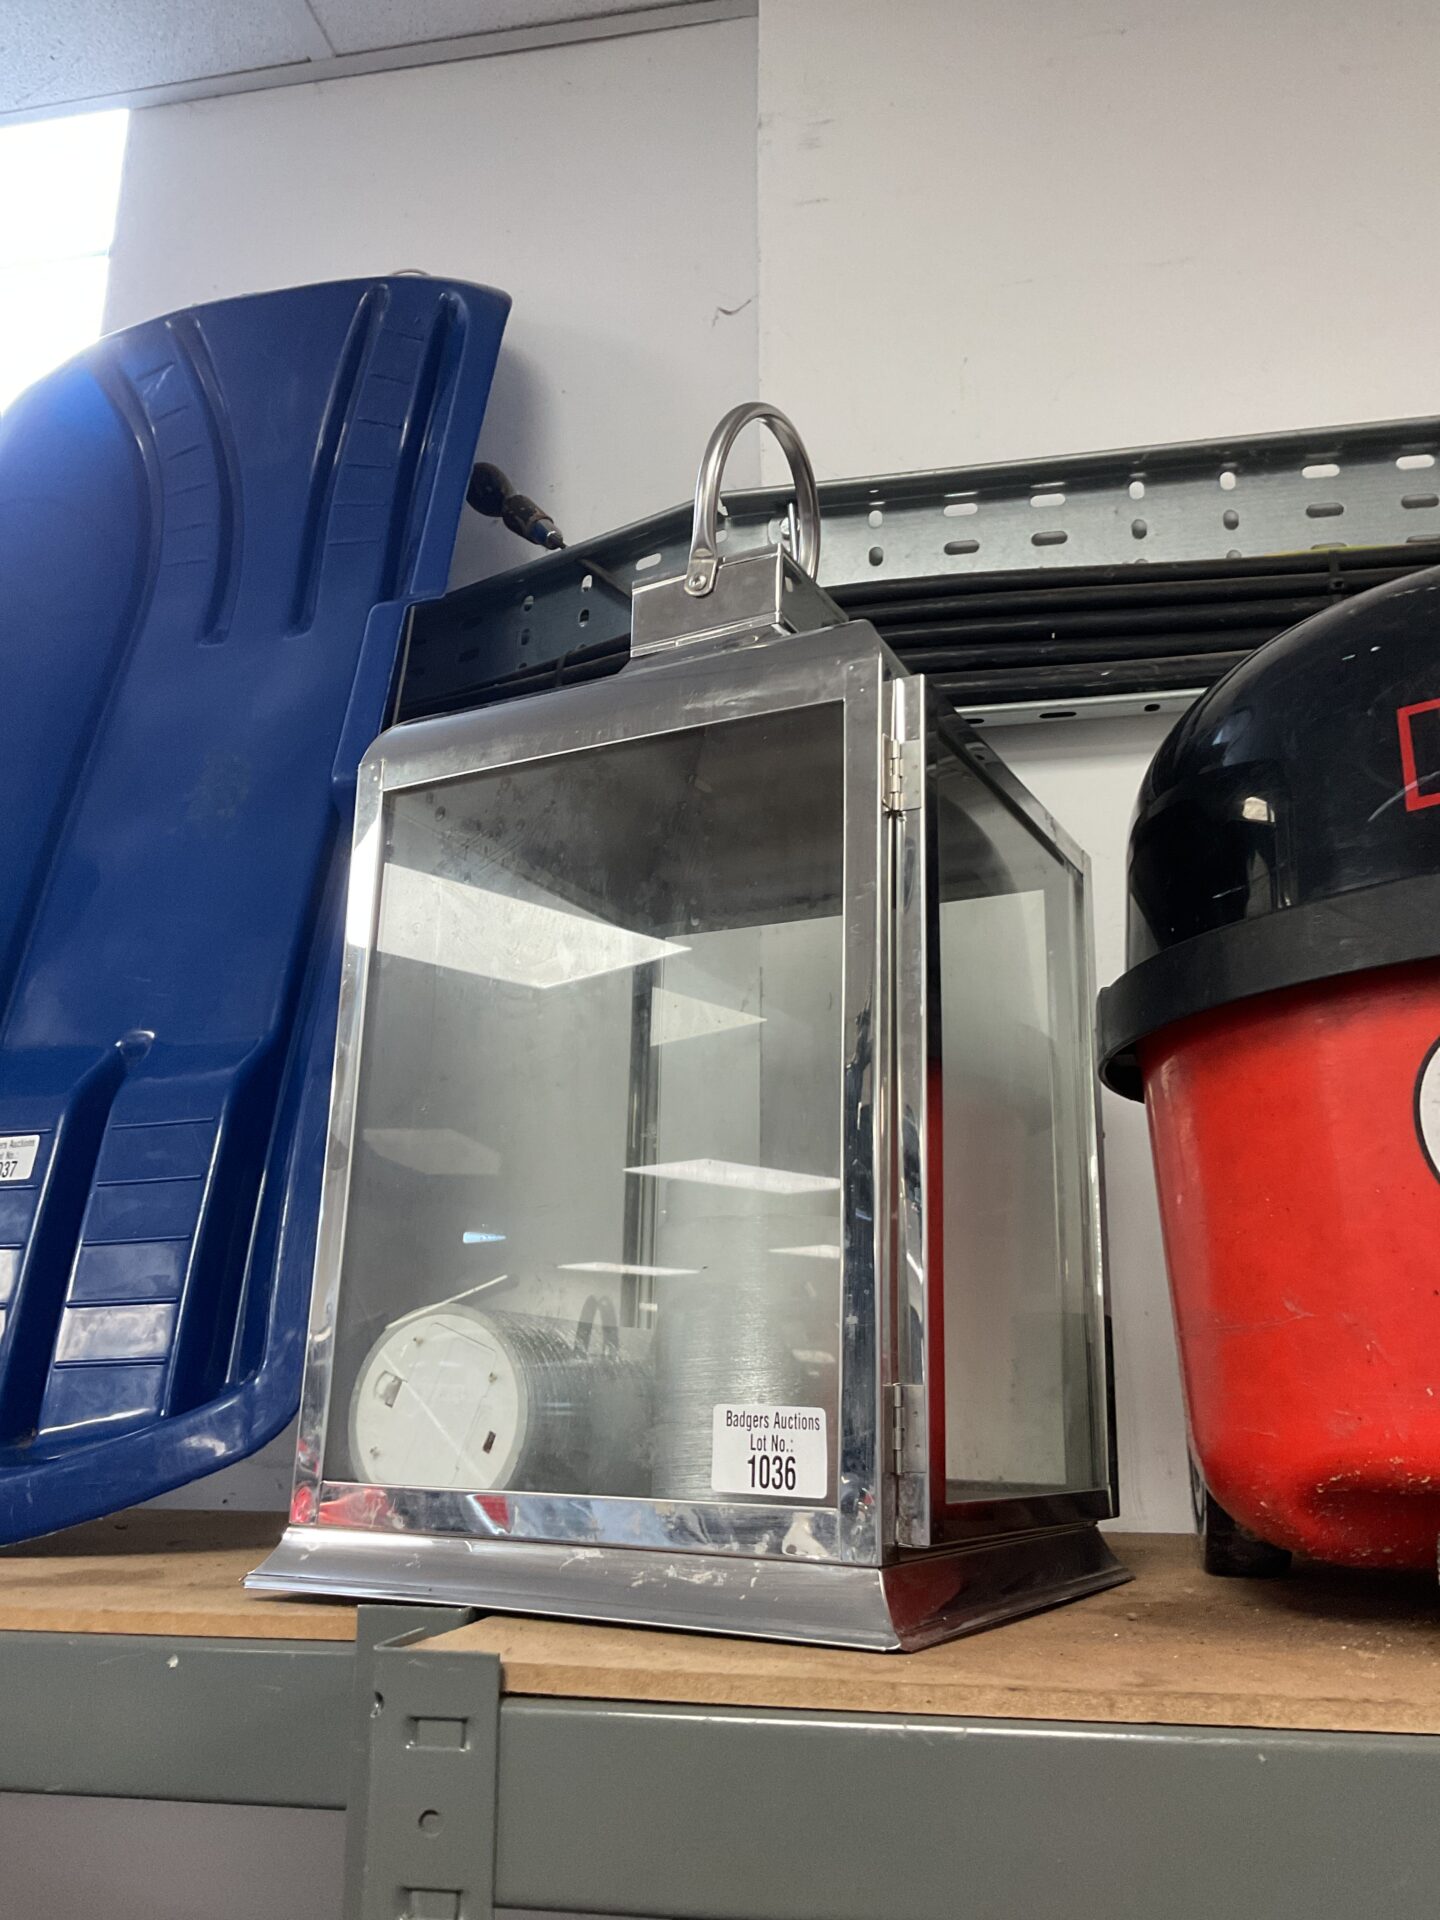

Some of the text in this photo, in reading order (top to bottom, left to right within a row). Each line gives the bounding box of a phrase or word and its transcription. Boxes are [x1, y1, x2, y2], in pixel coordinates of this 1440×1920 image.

[726, 1410, 820, 1431] Badgers Auctions
[750, 1434, 794, 1452] Lot No.:
[747, 1455, 796, 1490] 1036
